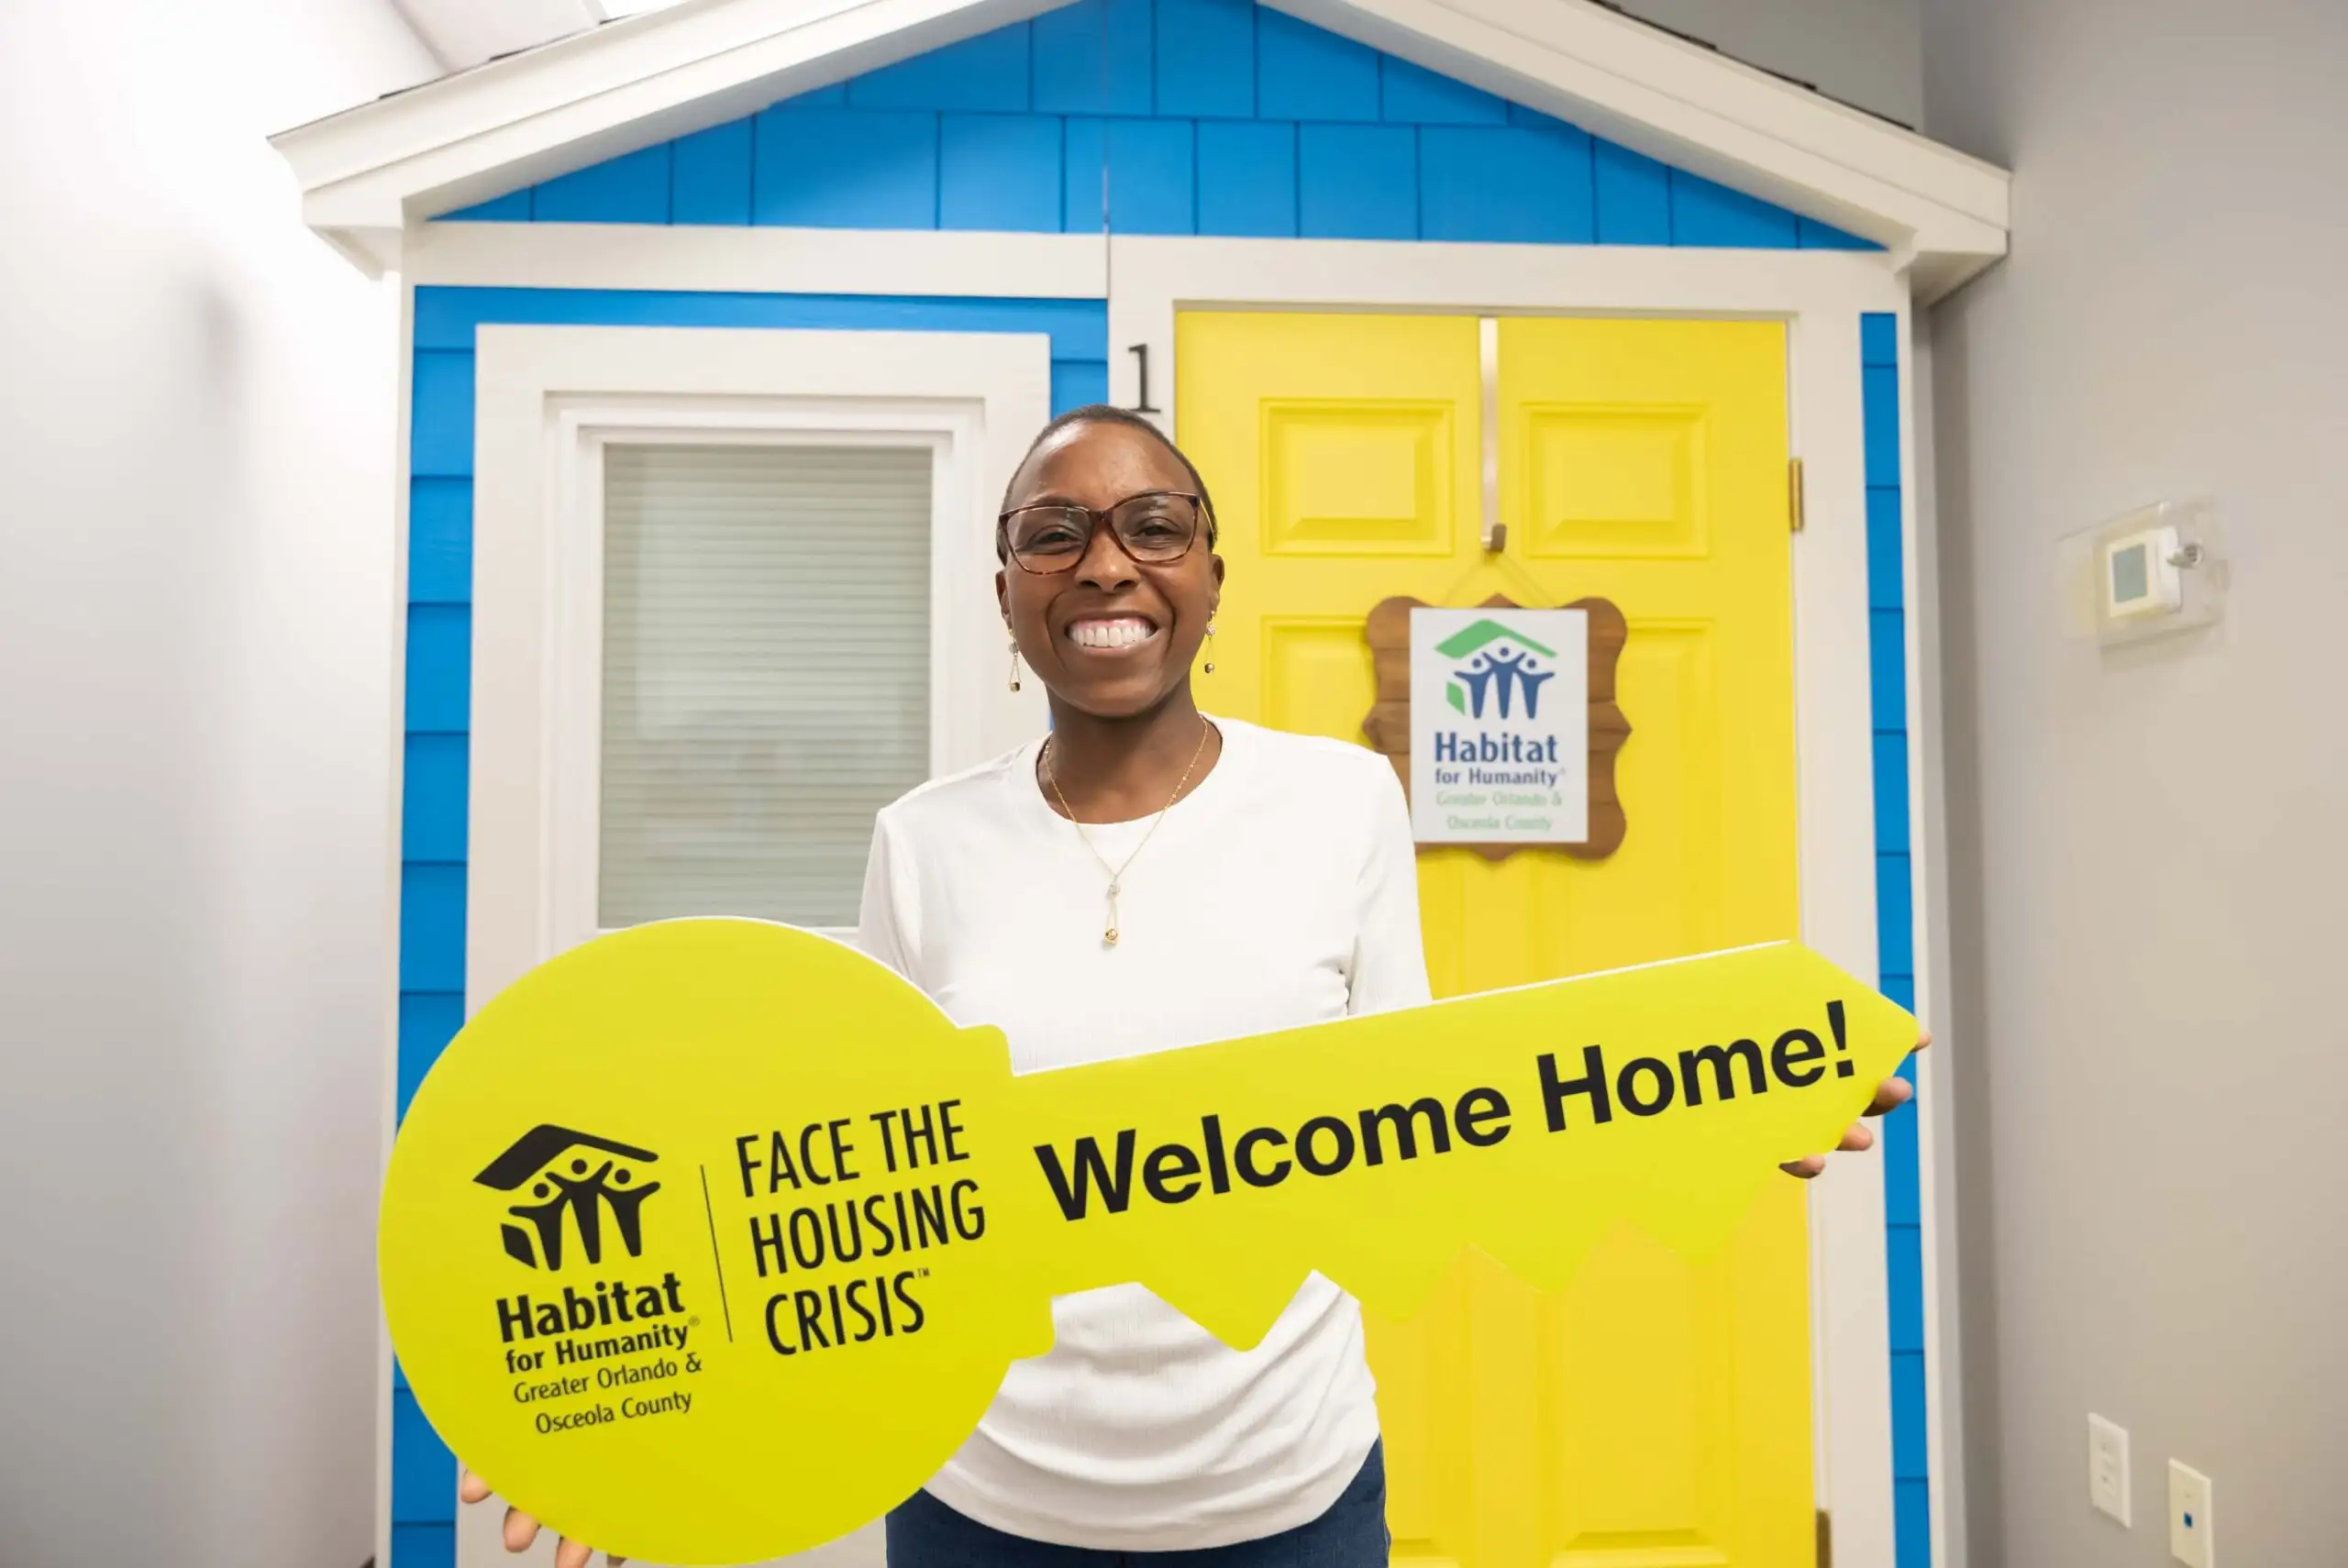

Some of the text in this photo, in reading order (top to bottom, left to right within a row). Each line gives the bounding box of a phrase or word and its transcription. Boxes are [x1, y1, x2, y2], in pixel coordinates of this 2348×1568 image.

[1128, 343, 1160, 413] 1
[1434, 732, 1558, 763] Habitat
[1434, 767, 1460, 784] for
[1034, 999, 1856, 1223] Welcome Home!
[736, 1099, 970, 1198] FACE THE
[748, 1178, 987, 1278] HOUSING
[495, 1271, 686, 1343] Habitat
[504, 1347, 547, 1375] for
[514, 1351, 703, 1405] Greater Orlando &
[534, 1389, 693, 1435] Osceola County
